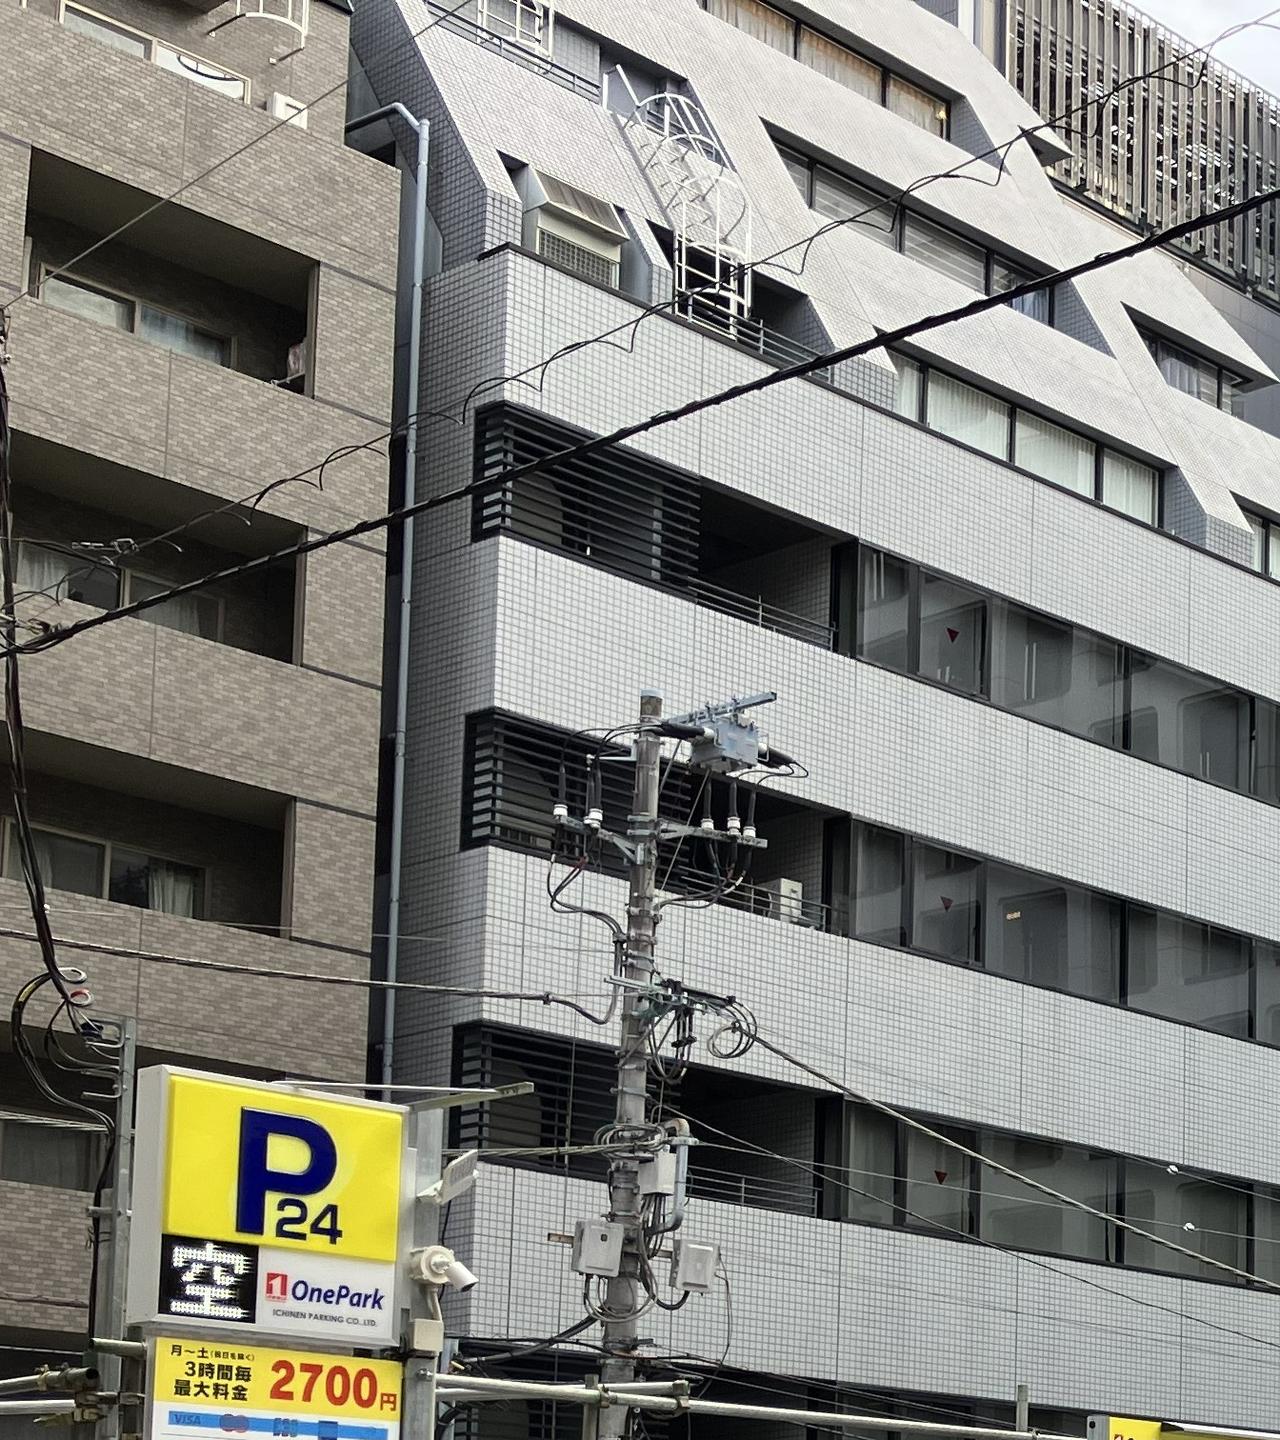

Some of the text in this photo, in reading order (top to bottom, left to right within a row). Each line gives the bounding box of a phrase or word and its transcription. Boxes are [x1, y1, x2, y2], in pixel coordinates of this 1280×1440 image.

[171, 1243, 251, 1318] 空
[291, 1280, 385, 1310] OnePark
[272, 1309, 306, 1319] ICHINEN
[308, 1312, 344, 1323] PARKING
[185, 1361, 252, 1382] 3時間毎
[174, 1379, 248, 1401] 最大料金
